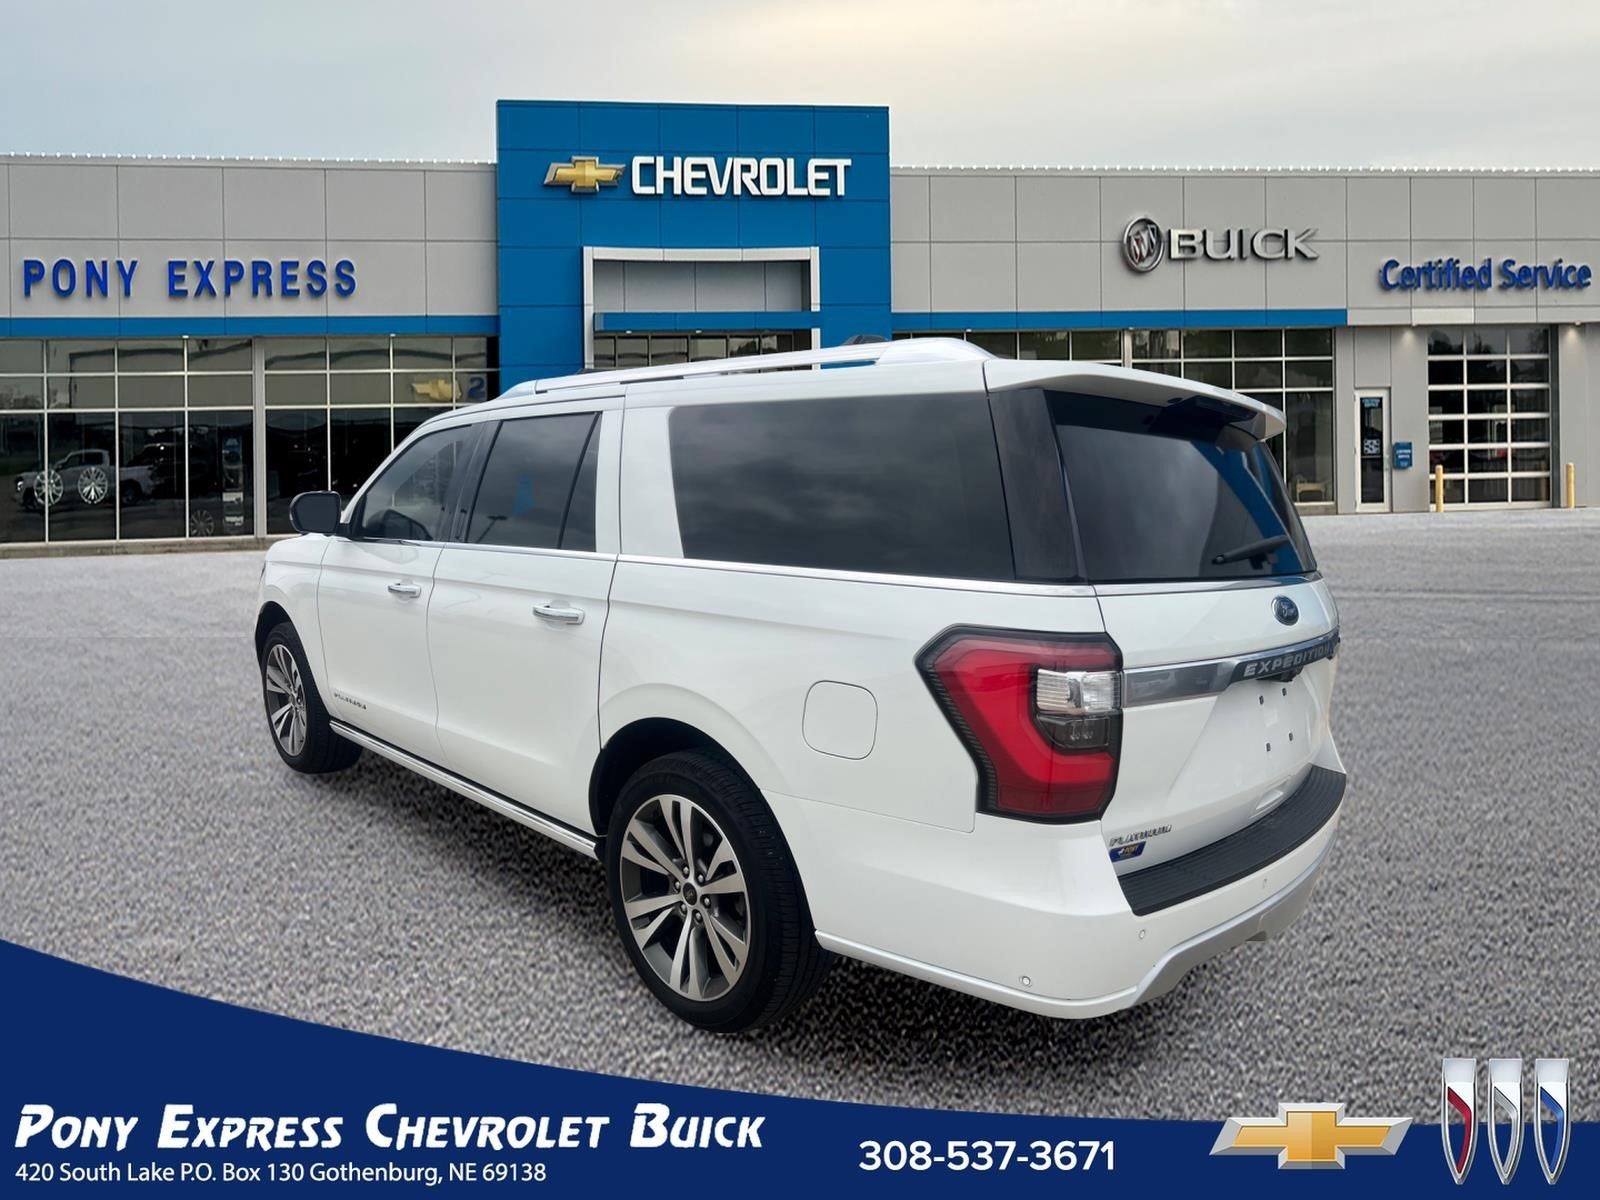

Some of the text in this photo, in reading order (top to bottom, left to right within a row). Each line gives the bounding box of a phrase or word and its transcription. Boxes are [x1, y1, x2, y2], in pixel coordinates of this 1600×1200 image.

[631, 155, 852, 196] CHEVROLET
[1168, 227, 1320, 261] BUICK
[22, 258, 358, 299] PONY EXPRESS
[1381, 257, 1592, 290] Certified Service
